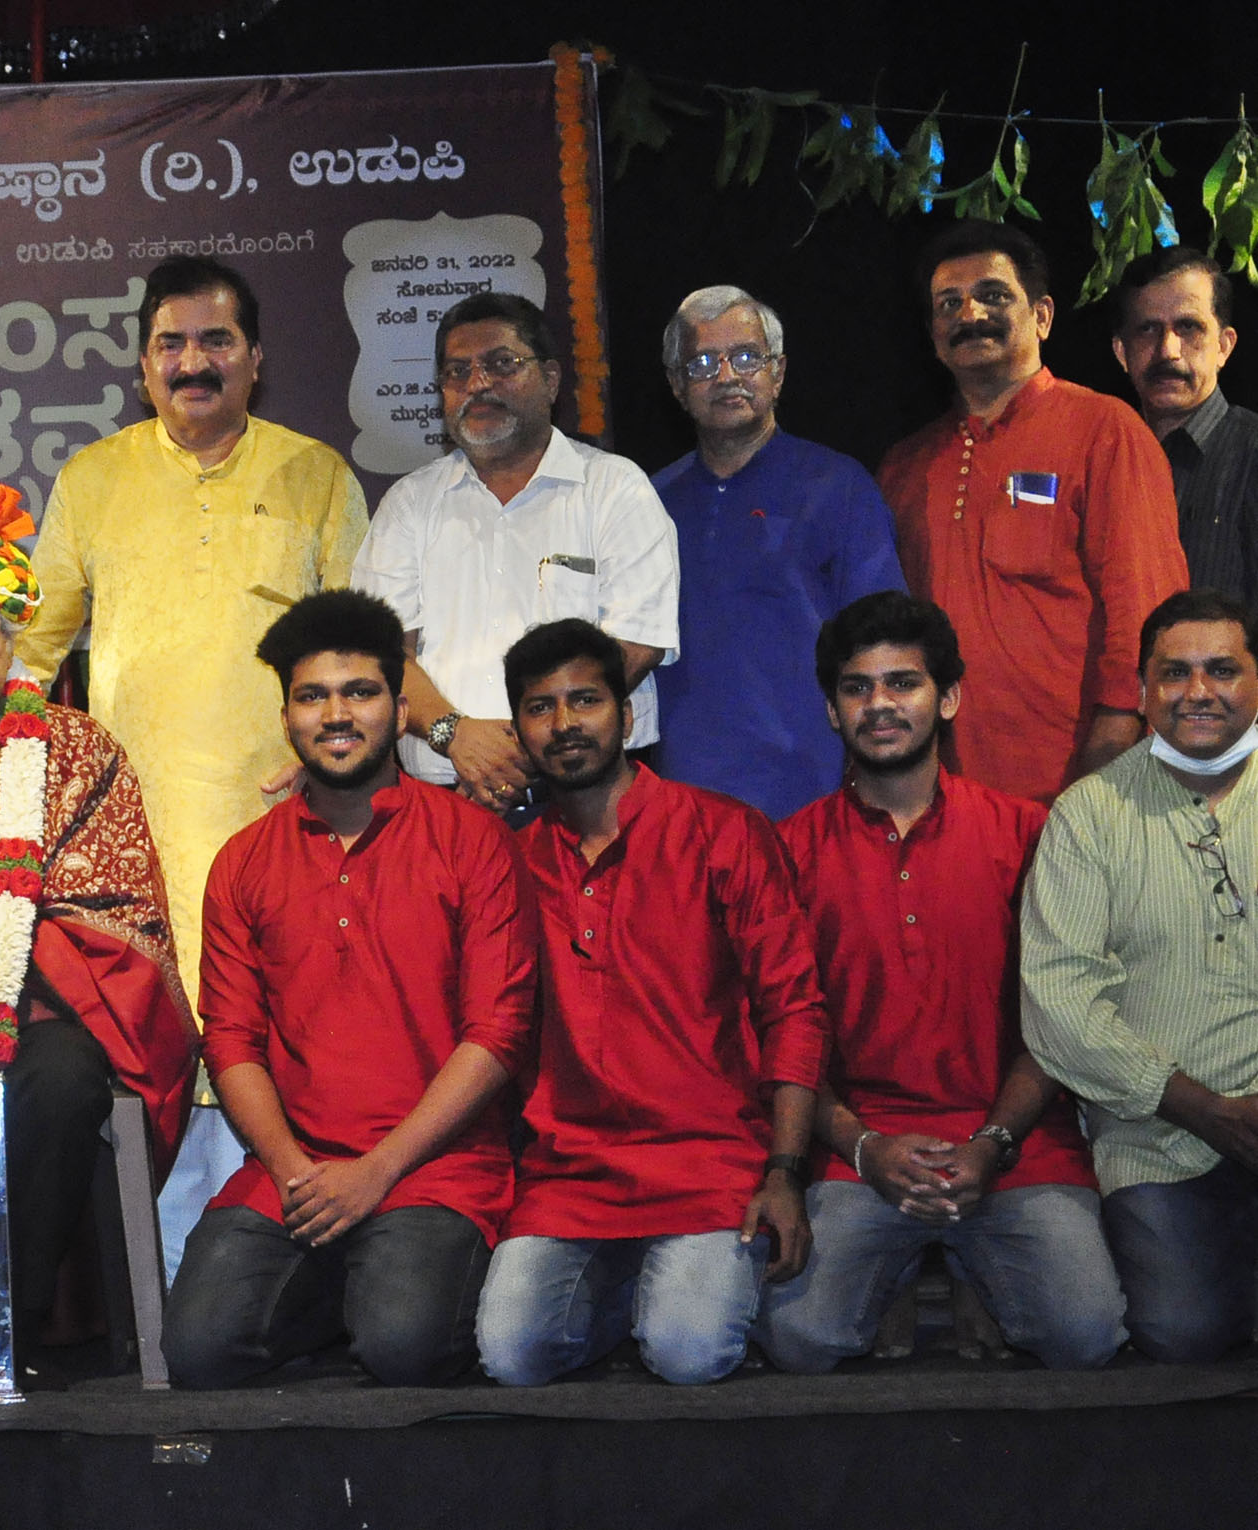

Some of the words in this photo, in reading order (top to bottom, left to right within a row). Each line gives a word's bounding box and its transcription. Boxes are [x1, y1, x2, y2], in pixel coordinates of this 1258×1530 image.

[290, 134, 465, 187] ಉಡುಪಿ
[16, 235, 114, 263] ಉಡುಪಿ
[371, 254, 428, 273] ಜನವರಿ
[436, 257, 461, 270] 31,
[469, 254, 516, 269] 2022
[396, 278, 492, 298] ಸೋಮವಾರ
[376, 306, 418, 325] ಸಂಜೆ
